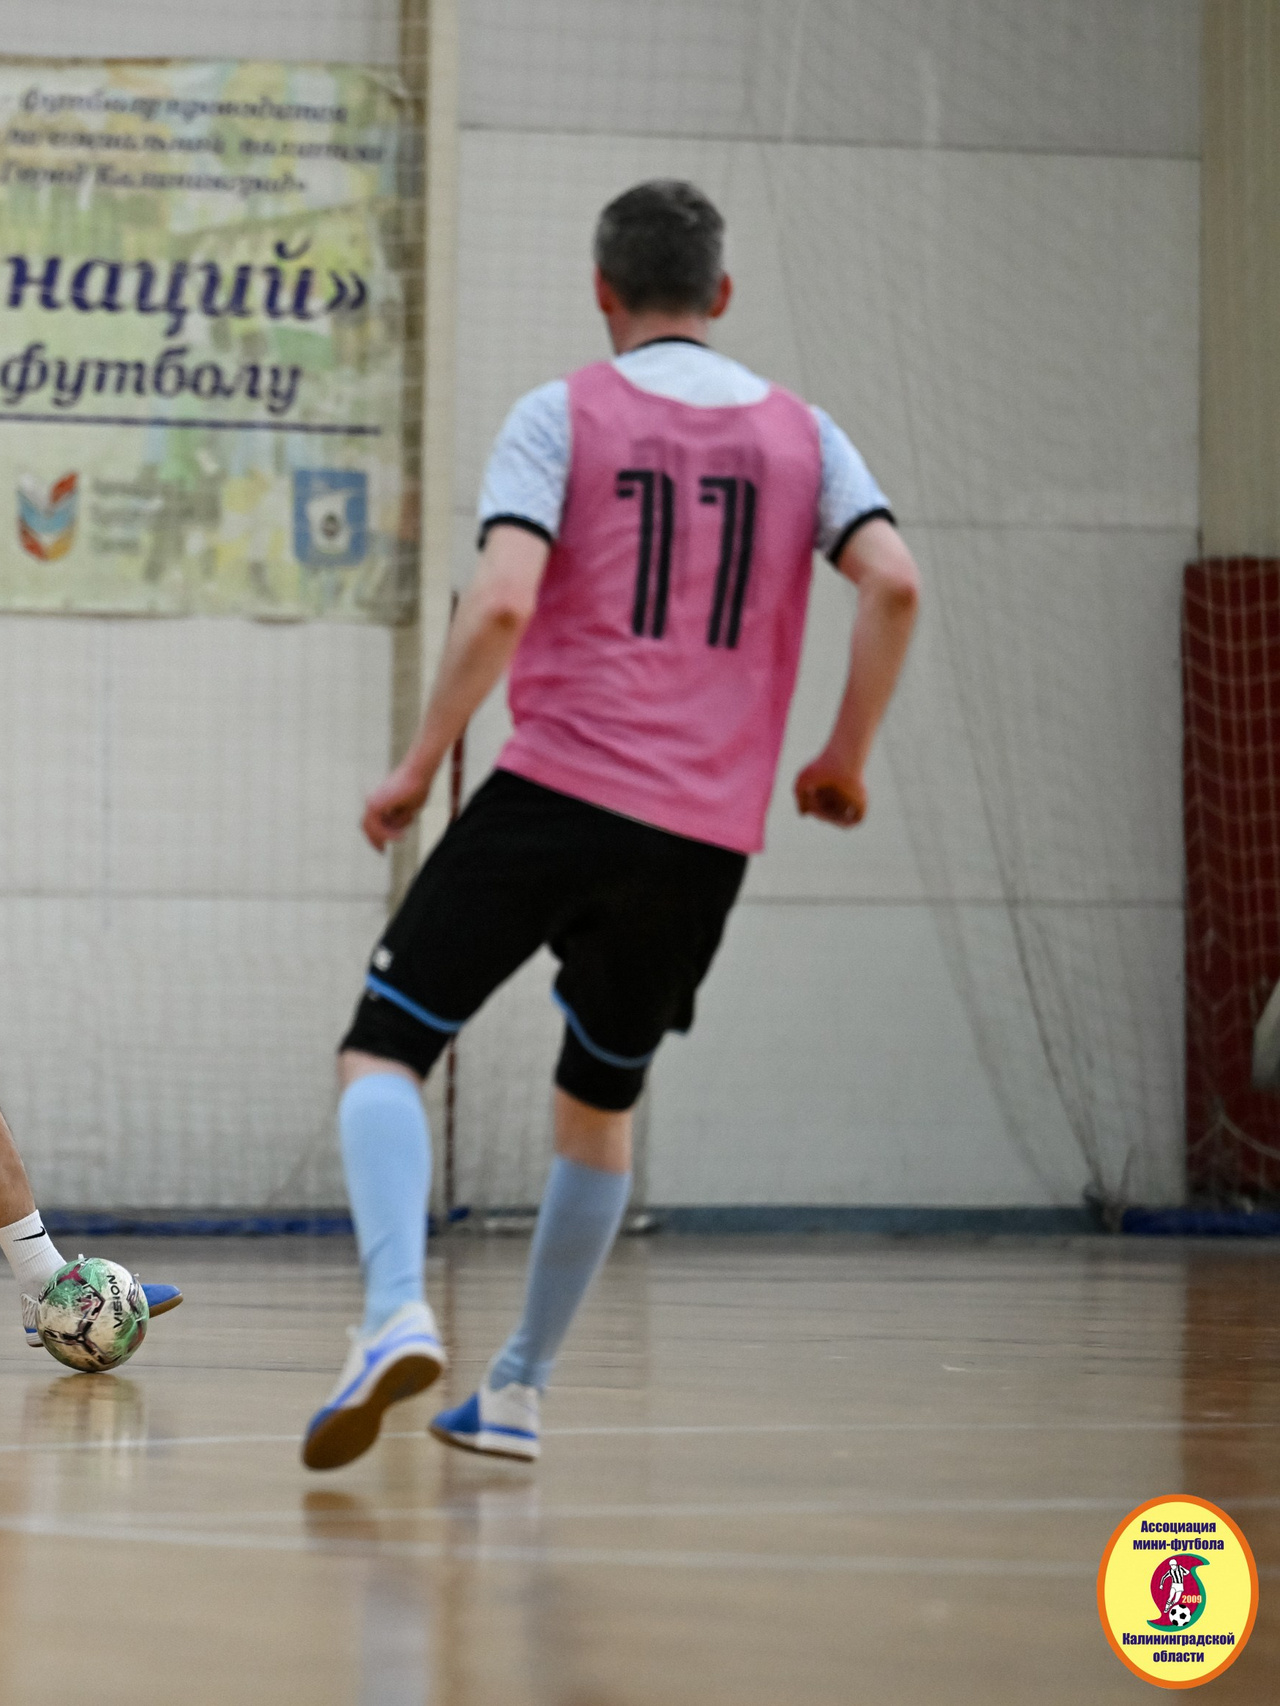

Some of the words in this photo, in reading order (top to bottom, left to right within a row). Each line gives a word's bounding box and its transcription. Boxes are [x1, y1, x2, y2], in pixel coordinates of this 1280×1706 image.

[5, 238, 368, 338] наций»
[617, 469, 756, 648] 11
[106, 1274, 123, 1329] VISION
